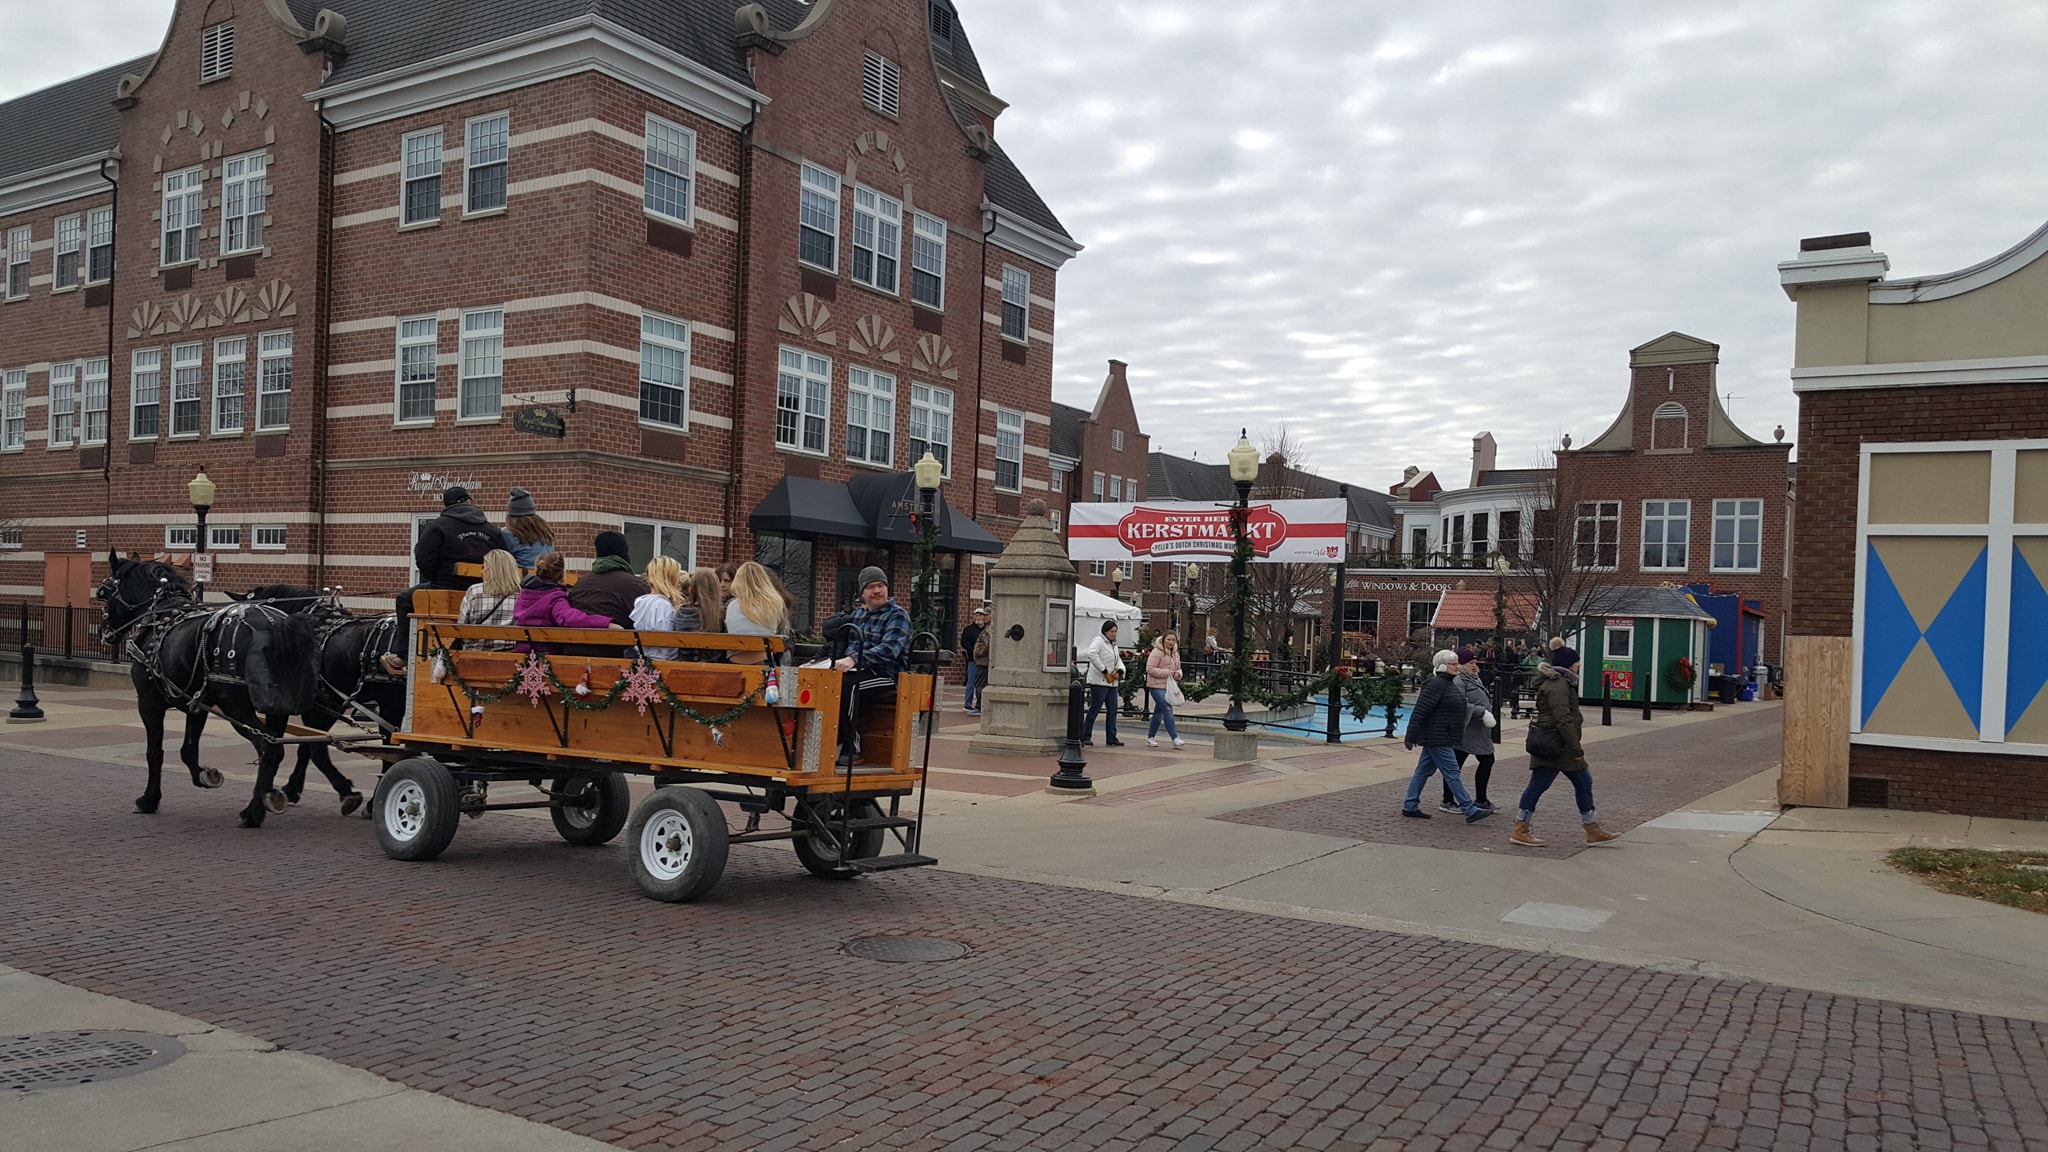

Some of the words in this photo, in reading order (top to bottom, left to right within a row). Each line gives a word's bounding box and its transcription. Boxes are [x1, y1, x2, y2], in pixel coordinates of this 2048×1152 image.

[407, 470, 436, 499] Royal
[434, 471, 482, 490] Amsterdam
[1204, 515, 1232, 523] HER
[1127, 522, 1277, 539] KERSTMAKT
[1175, 541, 1192, 549] DUTCH
[1192, 541, 1222, 549] CHRISTMAS
[1361, 581, 1408, 591] WINDOWS
[1408, 582, 1419, 591] &
[1421, 582, 1452, 592] DOORS
